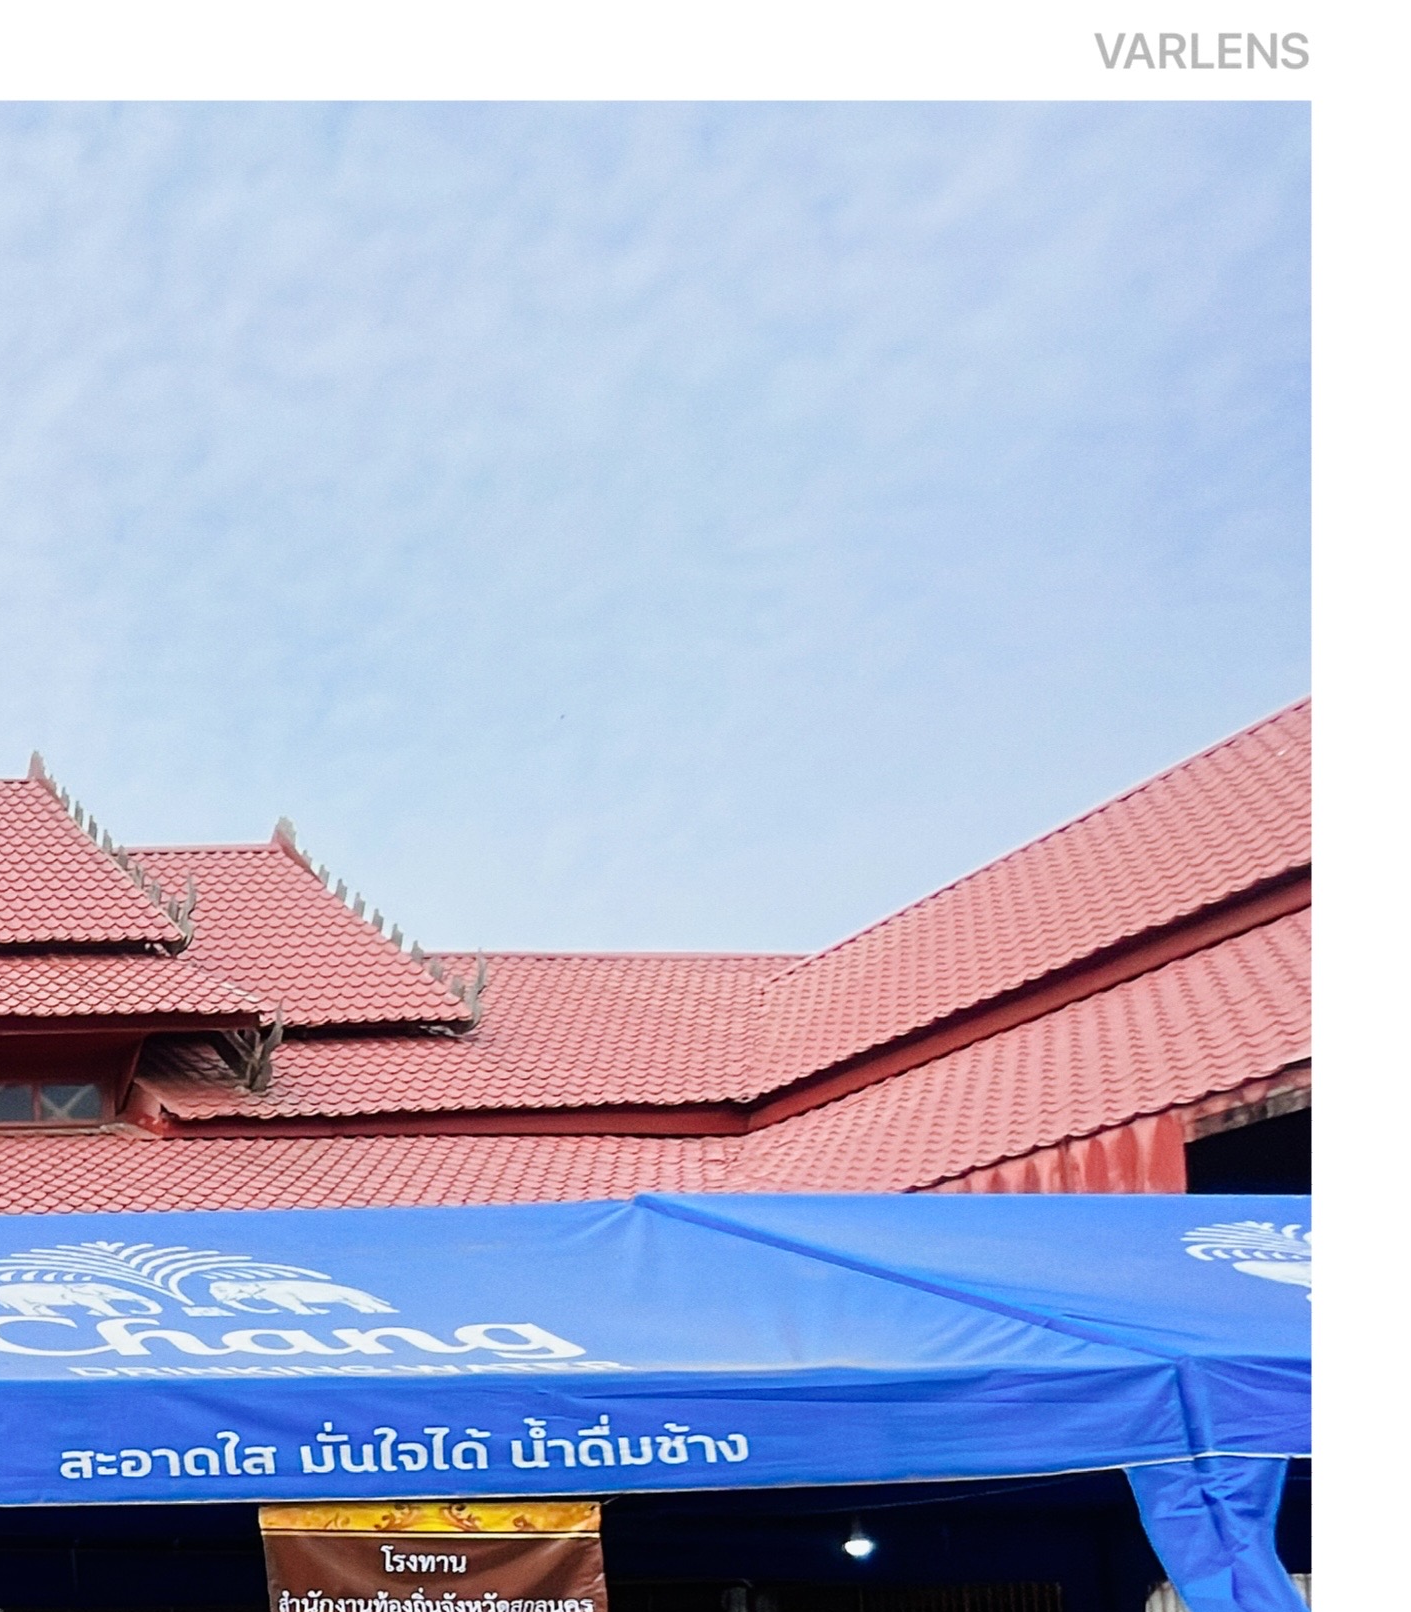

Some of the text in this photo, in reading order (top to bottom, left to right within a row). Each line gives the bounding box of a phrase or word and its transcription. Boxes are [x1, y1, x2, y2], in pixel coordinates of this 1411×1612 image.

[60, 1414, 749, 1479] สะอาดใส มั่นใจได้ น้ำดื่มช้าง
[381, 1545, 467, 1573] โรงทาน
